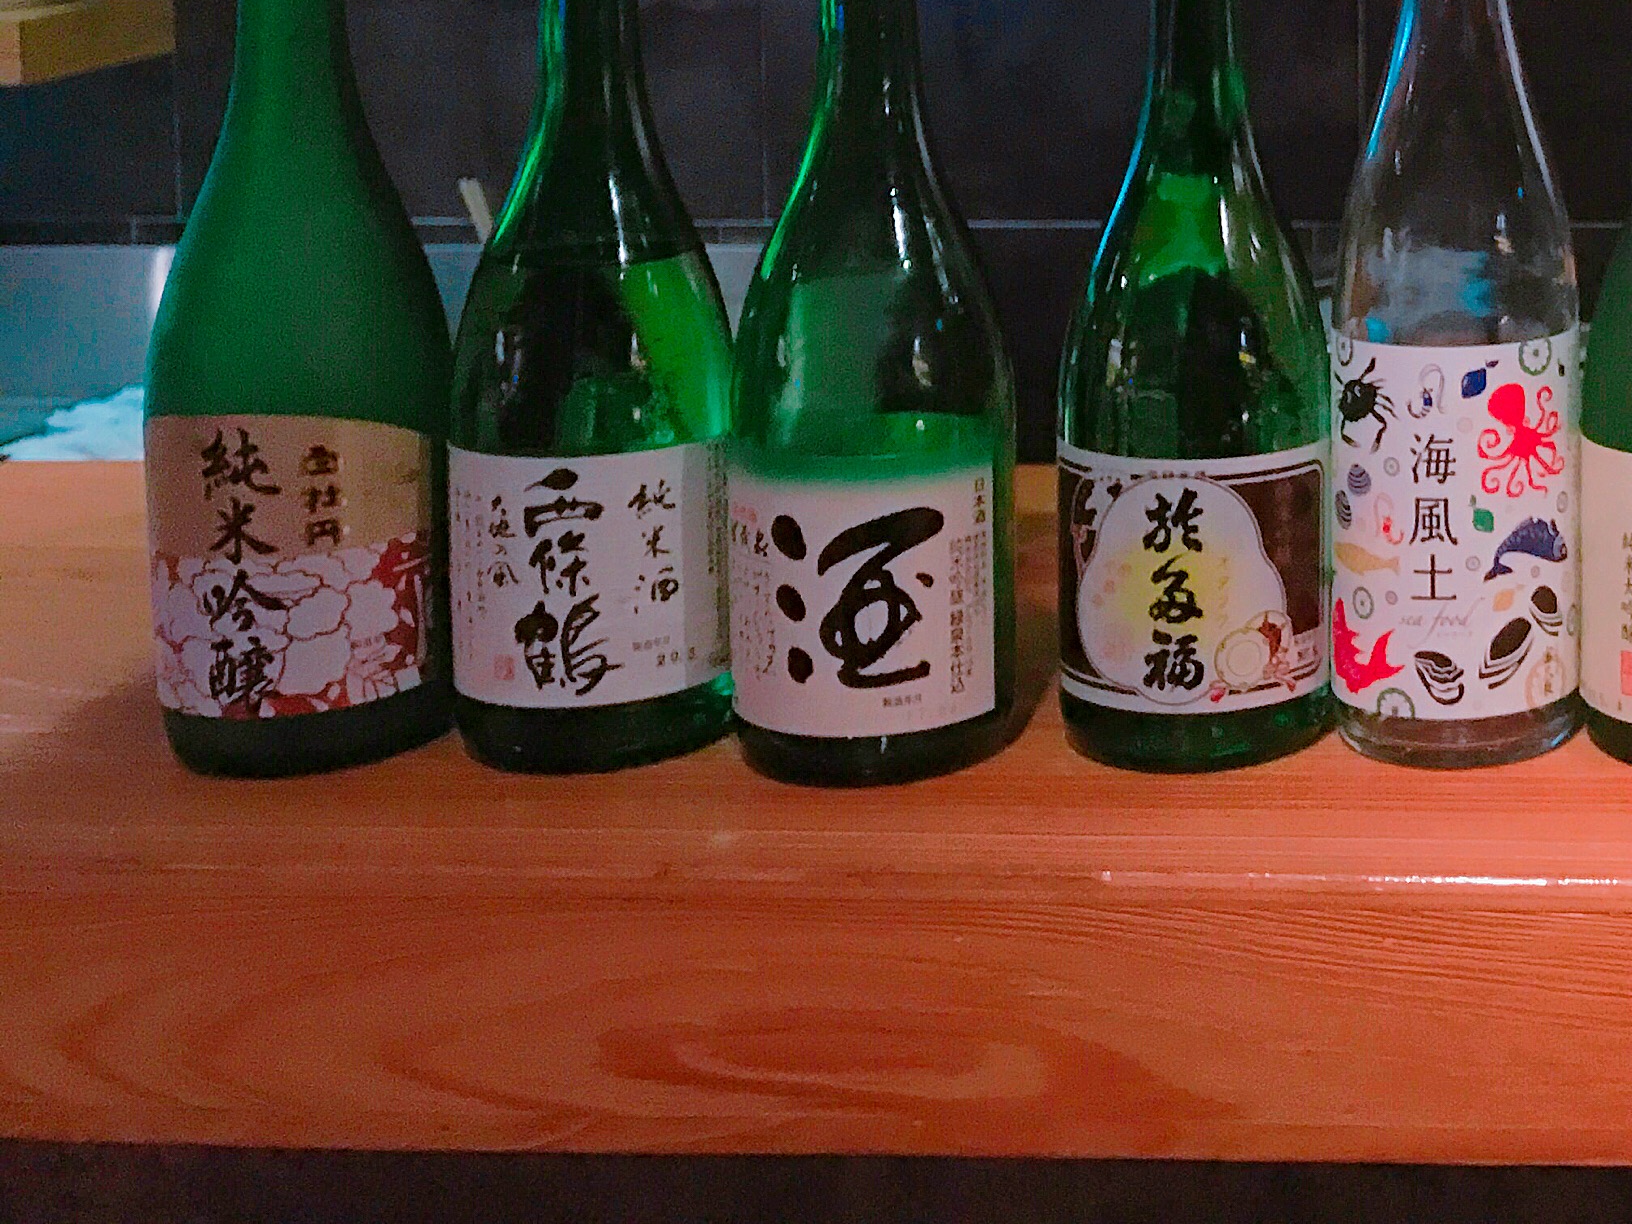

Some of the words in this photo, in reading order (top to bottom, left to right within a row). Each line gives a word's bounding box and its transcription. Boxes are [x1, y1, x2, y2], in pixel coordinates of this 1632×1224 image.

[200, 427, 282, 711] 純米吟醸
[628, 480, 678, 615] 純米酒
[770, 506, 944, 689] 酒
[1409, 433, 1458, 601] 海風土
